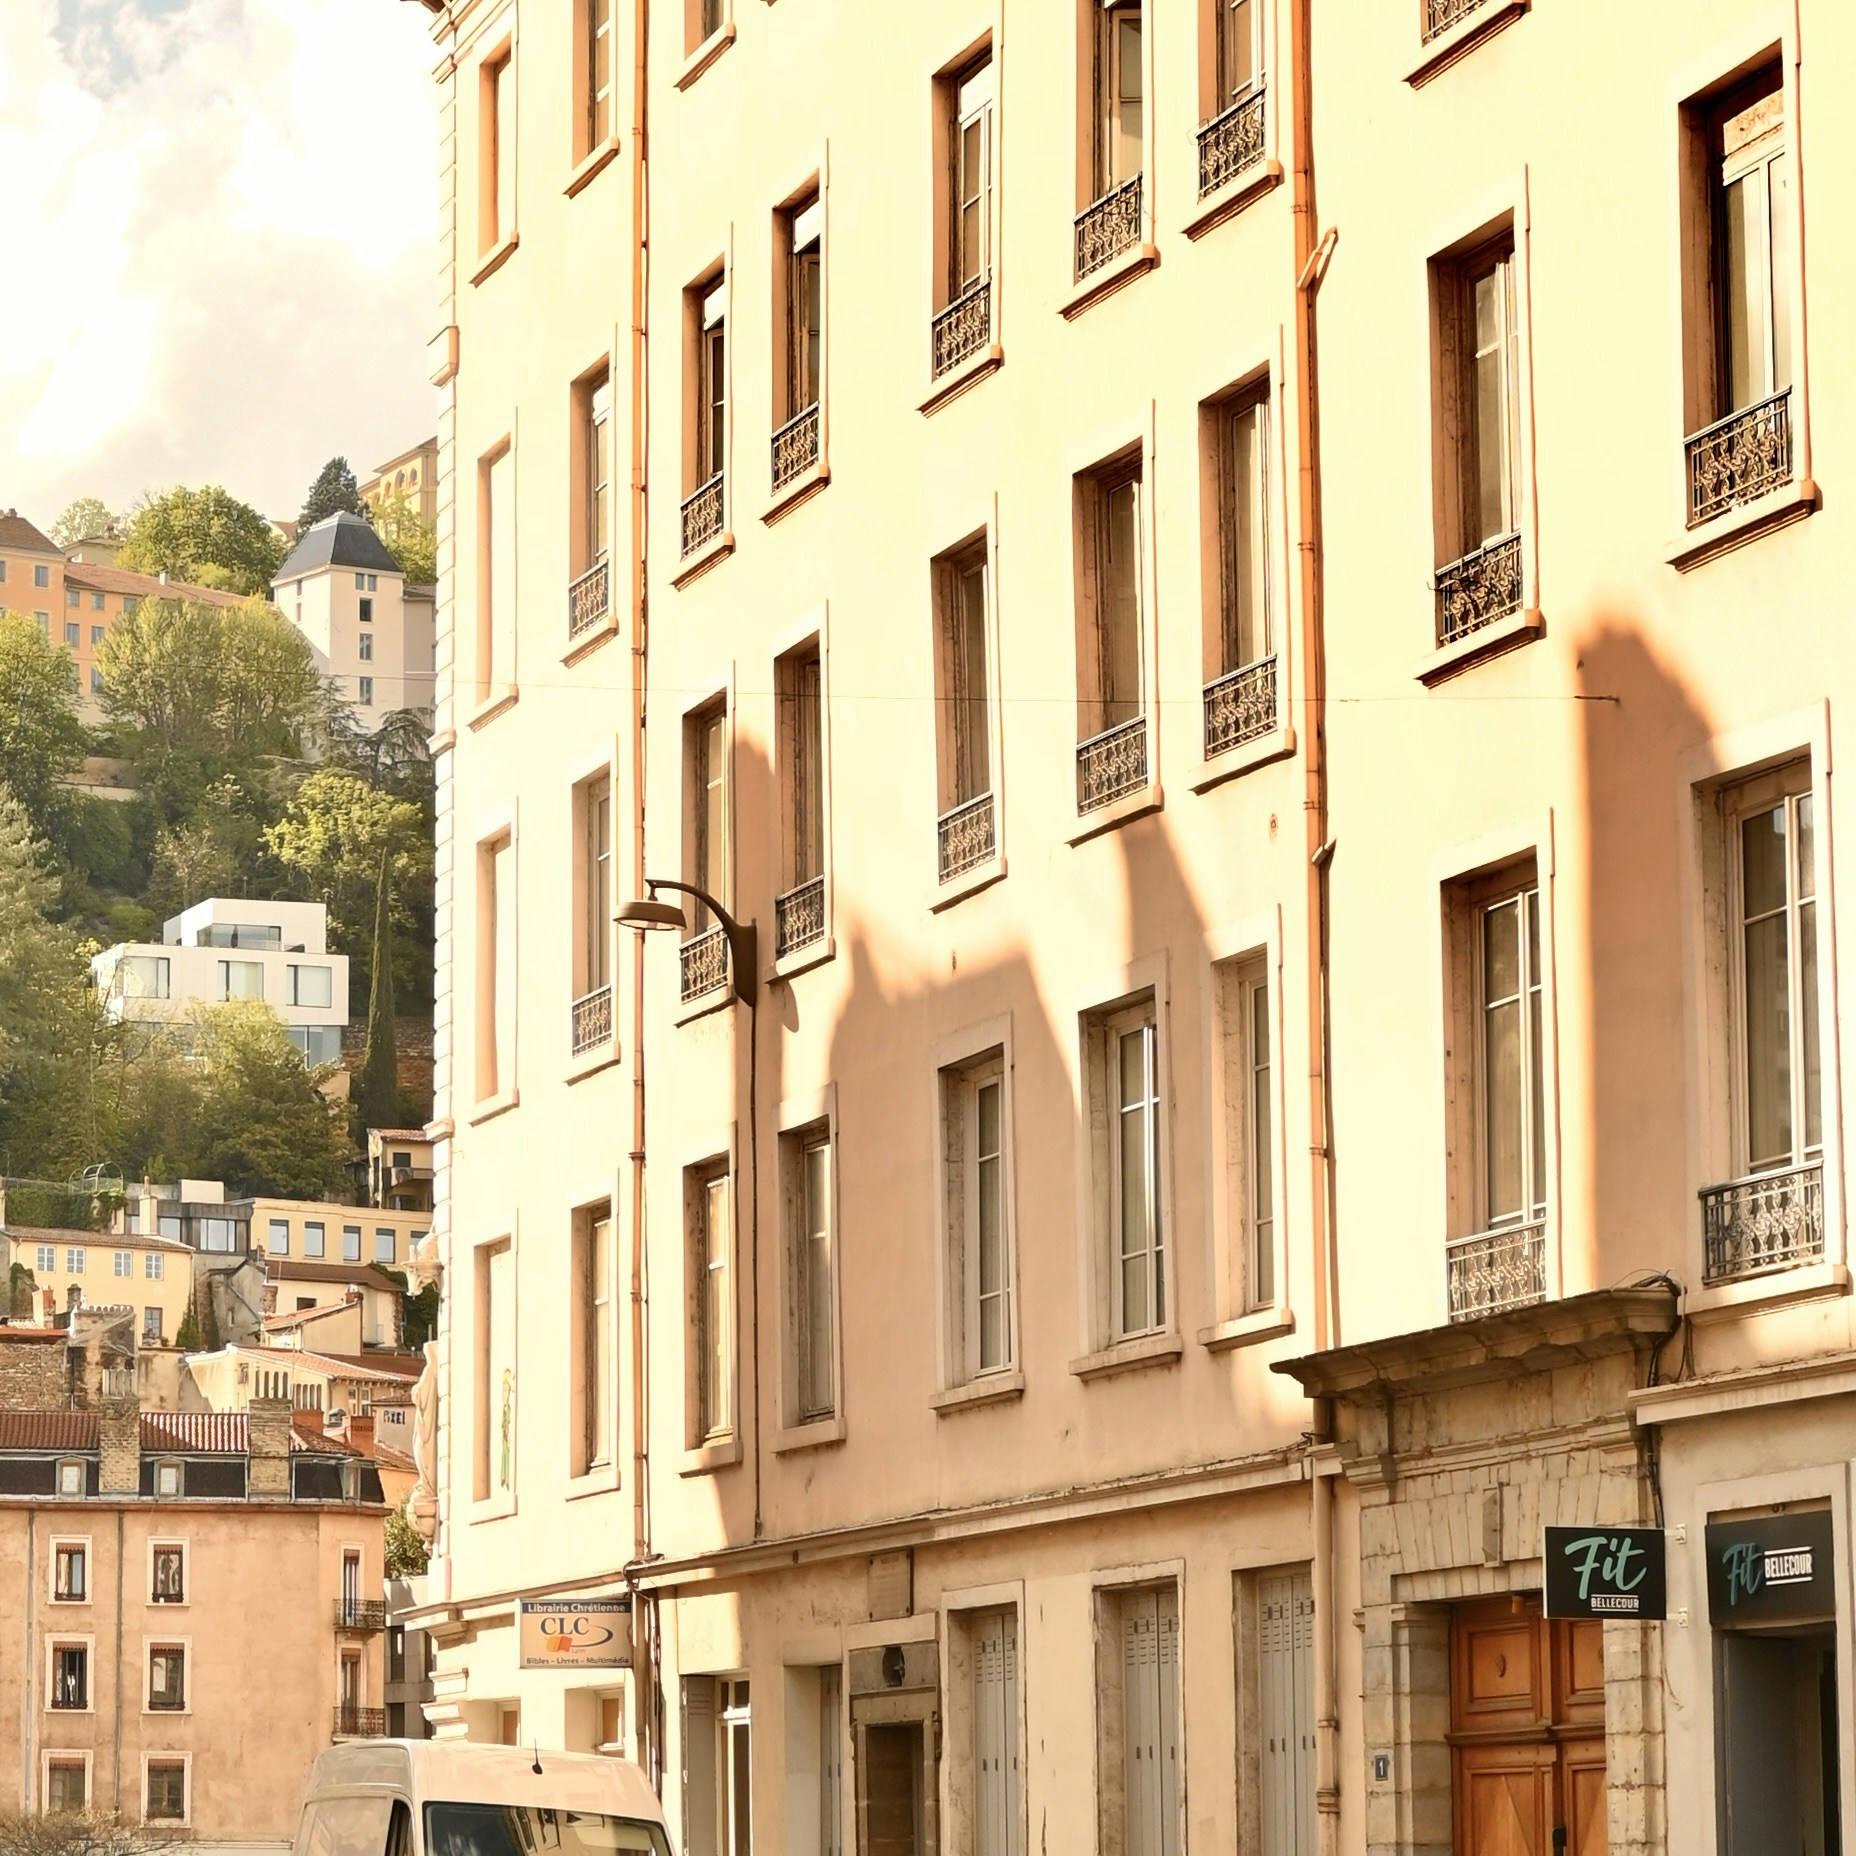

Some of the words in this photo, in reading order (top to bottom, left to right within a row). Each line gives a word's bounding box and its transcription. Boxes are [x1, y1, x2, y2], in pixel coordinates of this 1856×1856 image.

[1564, 1536, 1647, 1600] Fit
[1722, 1542, 1763, 1606] Fit
[1764, 1552, 1813, 1579] BELLECOUR
[528, 1603, 569, 1613] Librairie
[570, 1603, 626, 1613] Chrétienne
[1590, 1597, 1640, 1609] BELLECOUR
[540, 1616, 590, 1635] CLC
